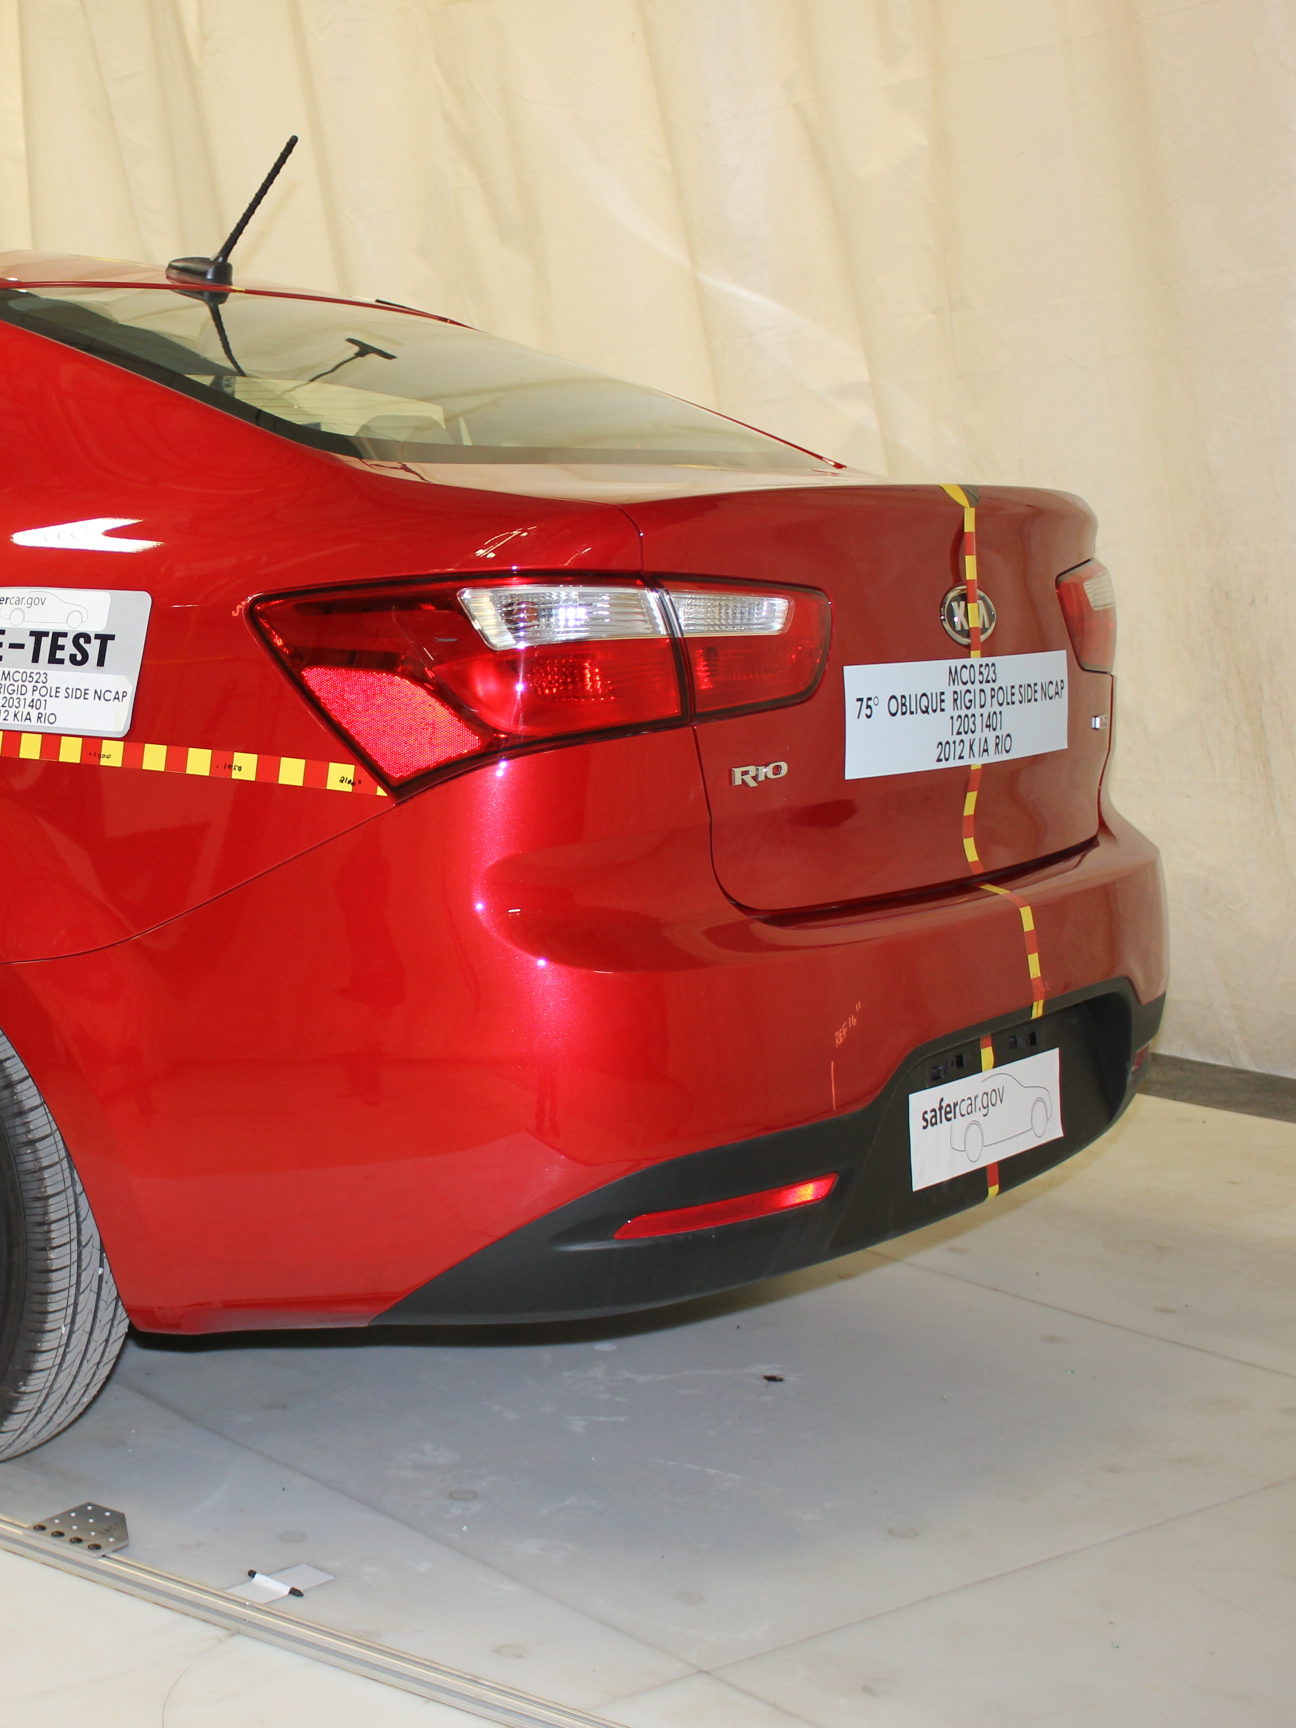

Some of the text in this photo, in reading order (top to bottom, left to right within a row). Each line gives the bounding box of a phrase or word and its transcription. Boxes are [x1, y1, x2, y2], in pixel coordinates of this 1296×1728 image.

[951, 599, 990, 630] KA
[0, 670, 49, 684] MC0523
[948, 662, 997, 686] MC0523
[31, 685, 64, 699] POLE
[65, 687, 90, 700] SIDE
[93, 689, 128, 703] NCAP
[855, 679, 1065, 720] 75° OBLIQUE RIGID POLE SIDE NCAP
[13, 709, 33, 723] KIA
[36, 711, 58, 725] RIO
[949, 710, 1004, 736] 12031401
[935, 733, 1013, 763] 2012 KIA RIO
[921, 1085, 1005, 1130] safercar.gov
